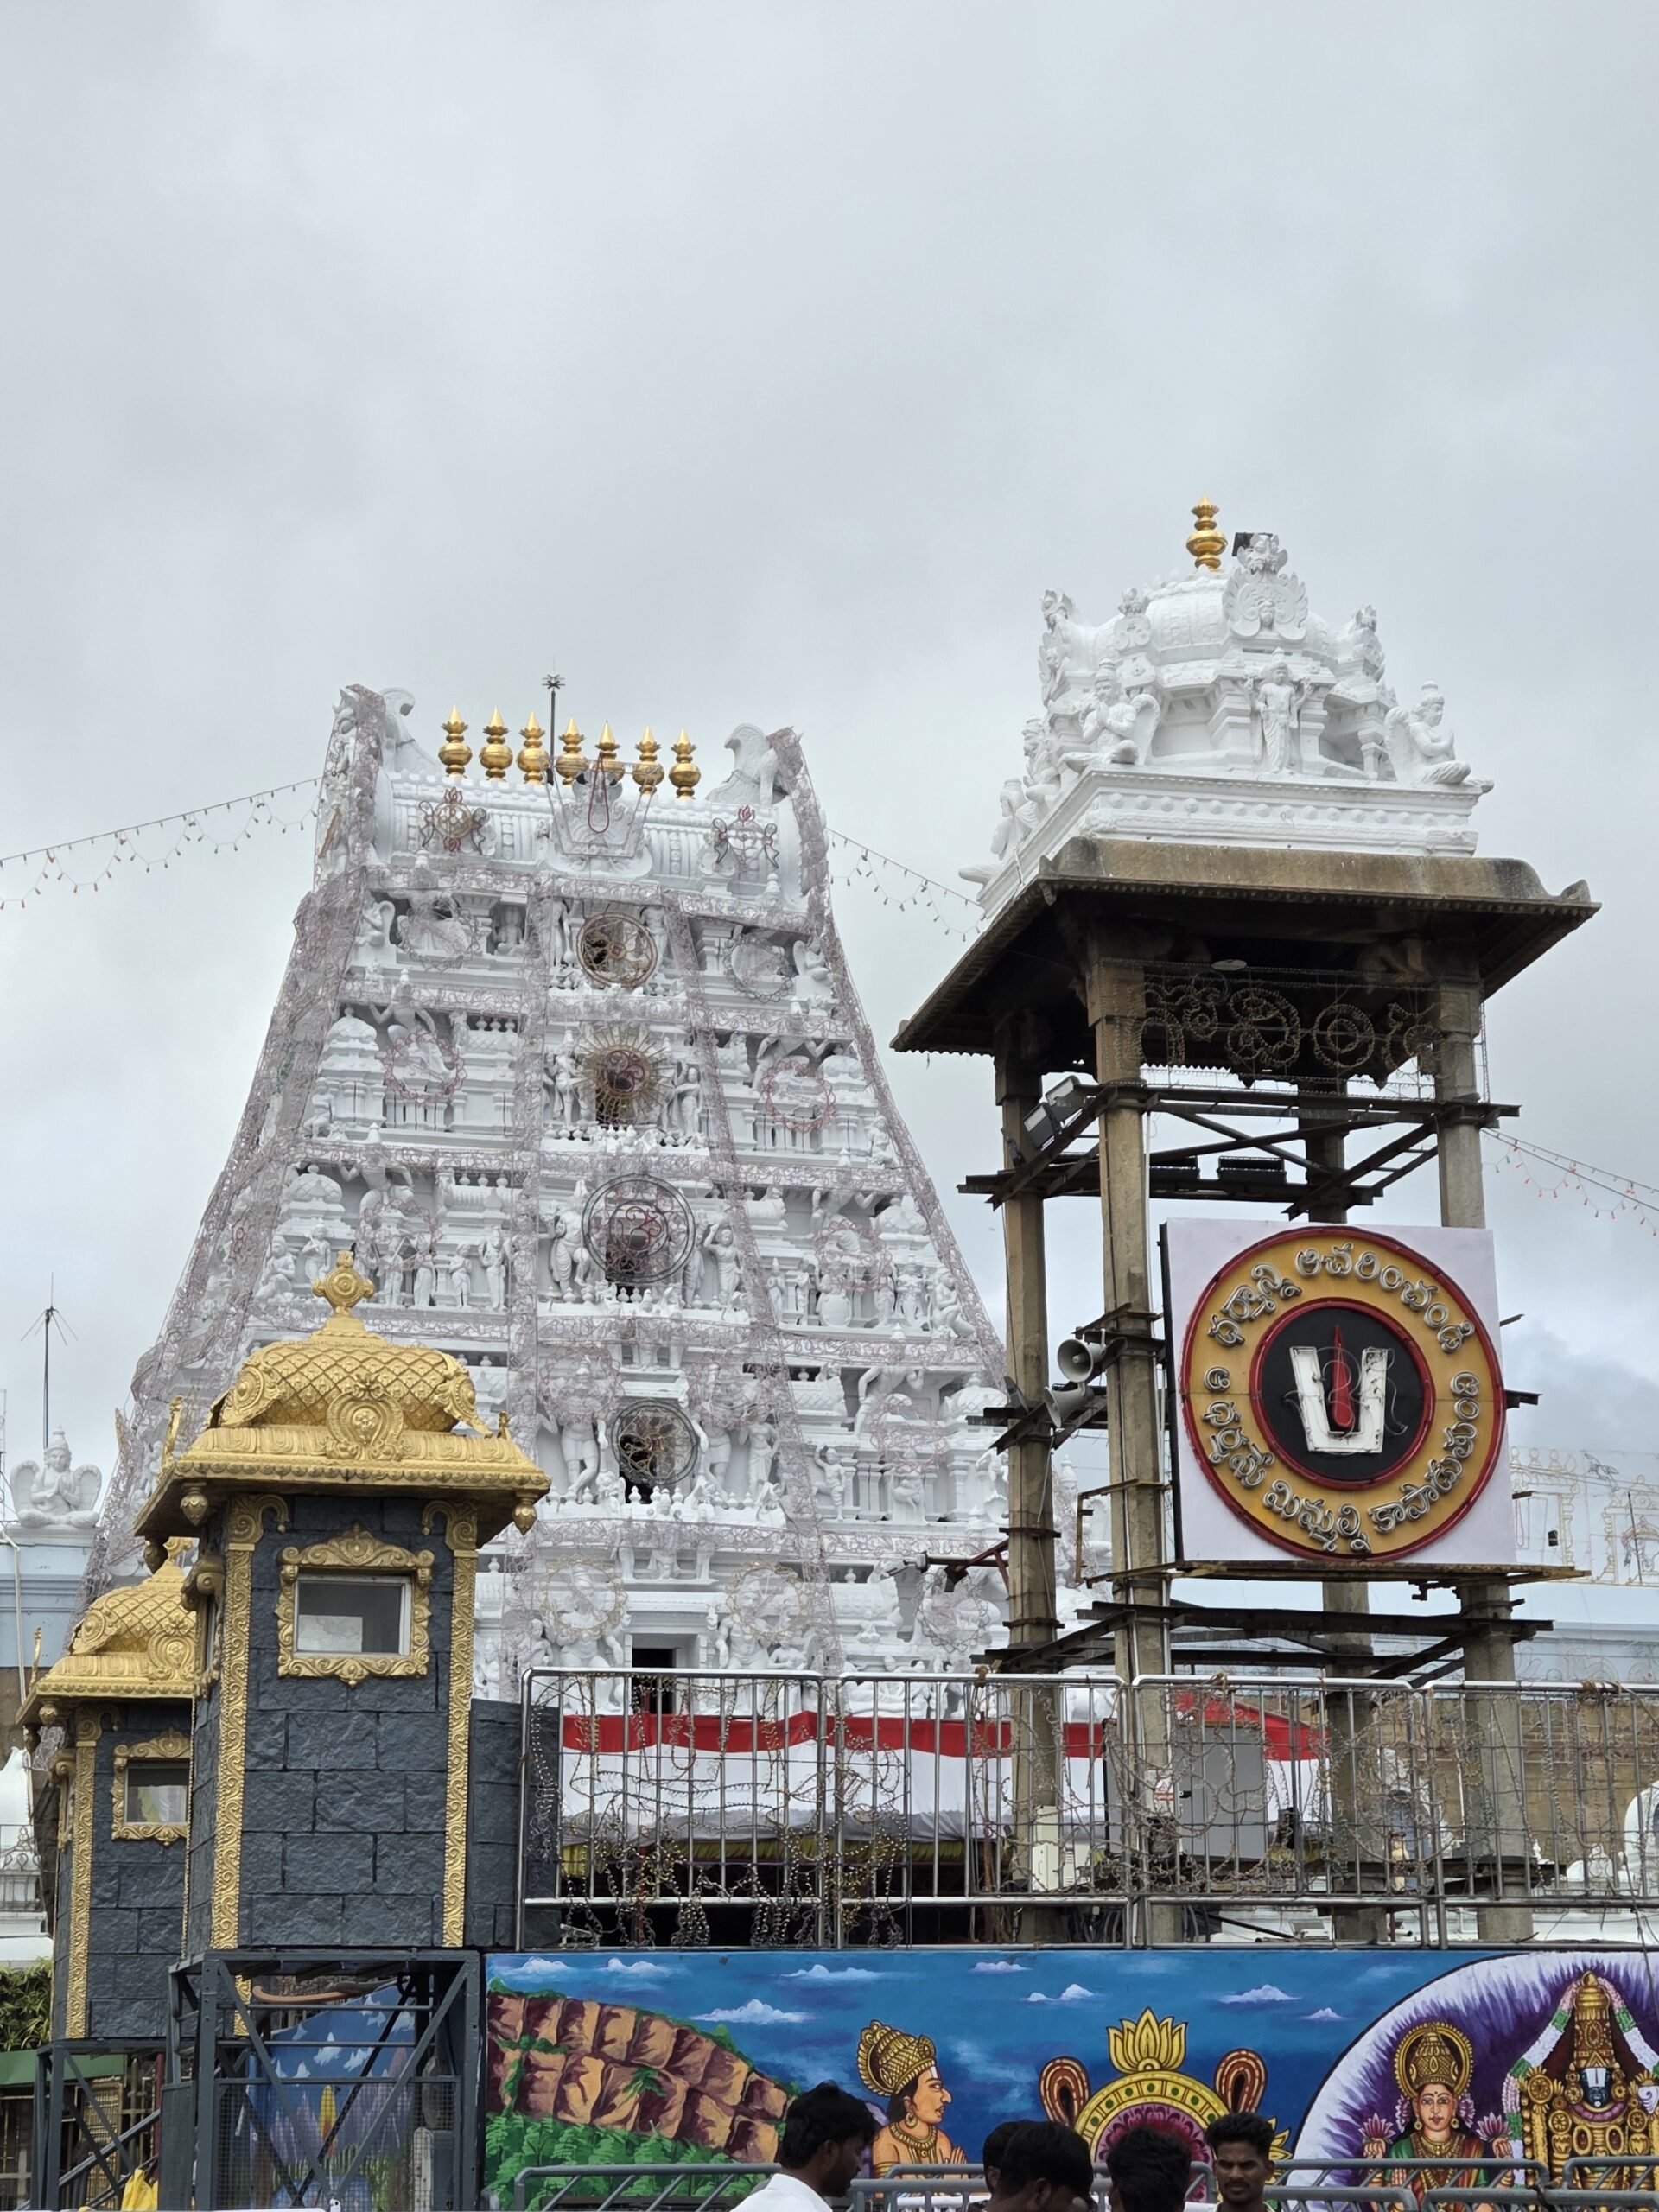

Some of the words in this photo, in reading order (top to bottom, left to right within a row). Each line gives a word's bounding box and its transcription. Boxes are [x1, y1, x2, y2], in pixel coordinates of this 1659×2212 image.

[1207, 1262, 1302, 1346] ధర్మాన్ని
[1295, 1243, 1474, 1353] ఆచరించండి
[1203, 1366, 1231, 1392] ఆ
[1201, 1400, 1274, 1488] ధర్మమే
[1367, 1370, 1481, 1534] కాపాడుతుంది
[1262, 1479, 1372, 1553] మిమ్మల్ని
